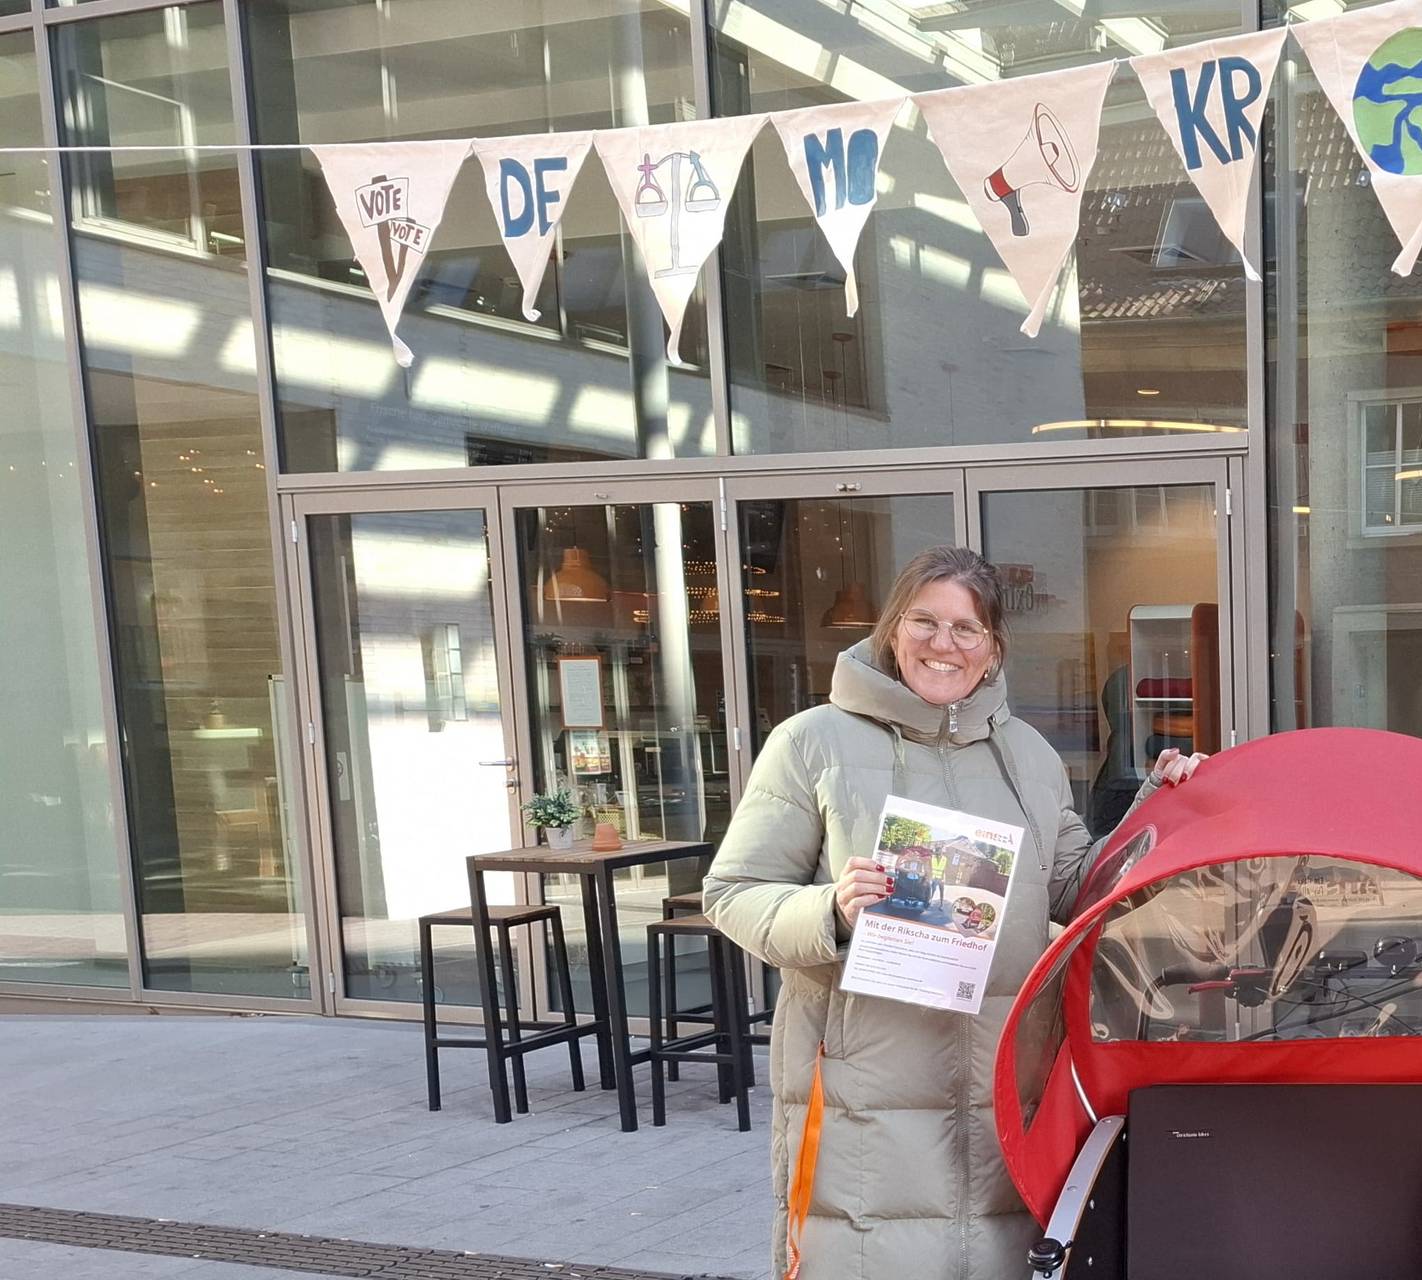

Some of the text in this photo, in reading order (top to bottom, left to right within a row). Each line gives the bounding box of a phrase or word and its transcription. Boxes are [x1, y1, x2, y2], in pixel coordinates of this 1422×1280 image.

[1170, 57, 1262, 170] KR
[499, 157, 567, 238] DE
[803, 127, 878, 217] MO
[360, 184, 402, 220] VOTE
[392, 220, 423, 245] VOTE
[865, 919, 879, 930] Mit
[881, 923, 896, 932] der
[897, 926, 930, 939] Rikscha
[931, 935, 950, 944] zum
[951, 937, 988, 952] Friedhof
